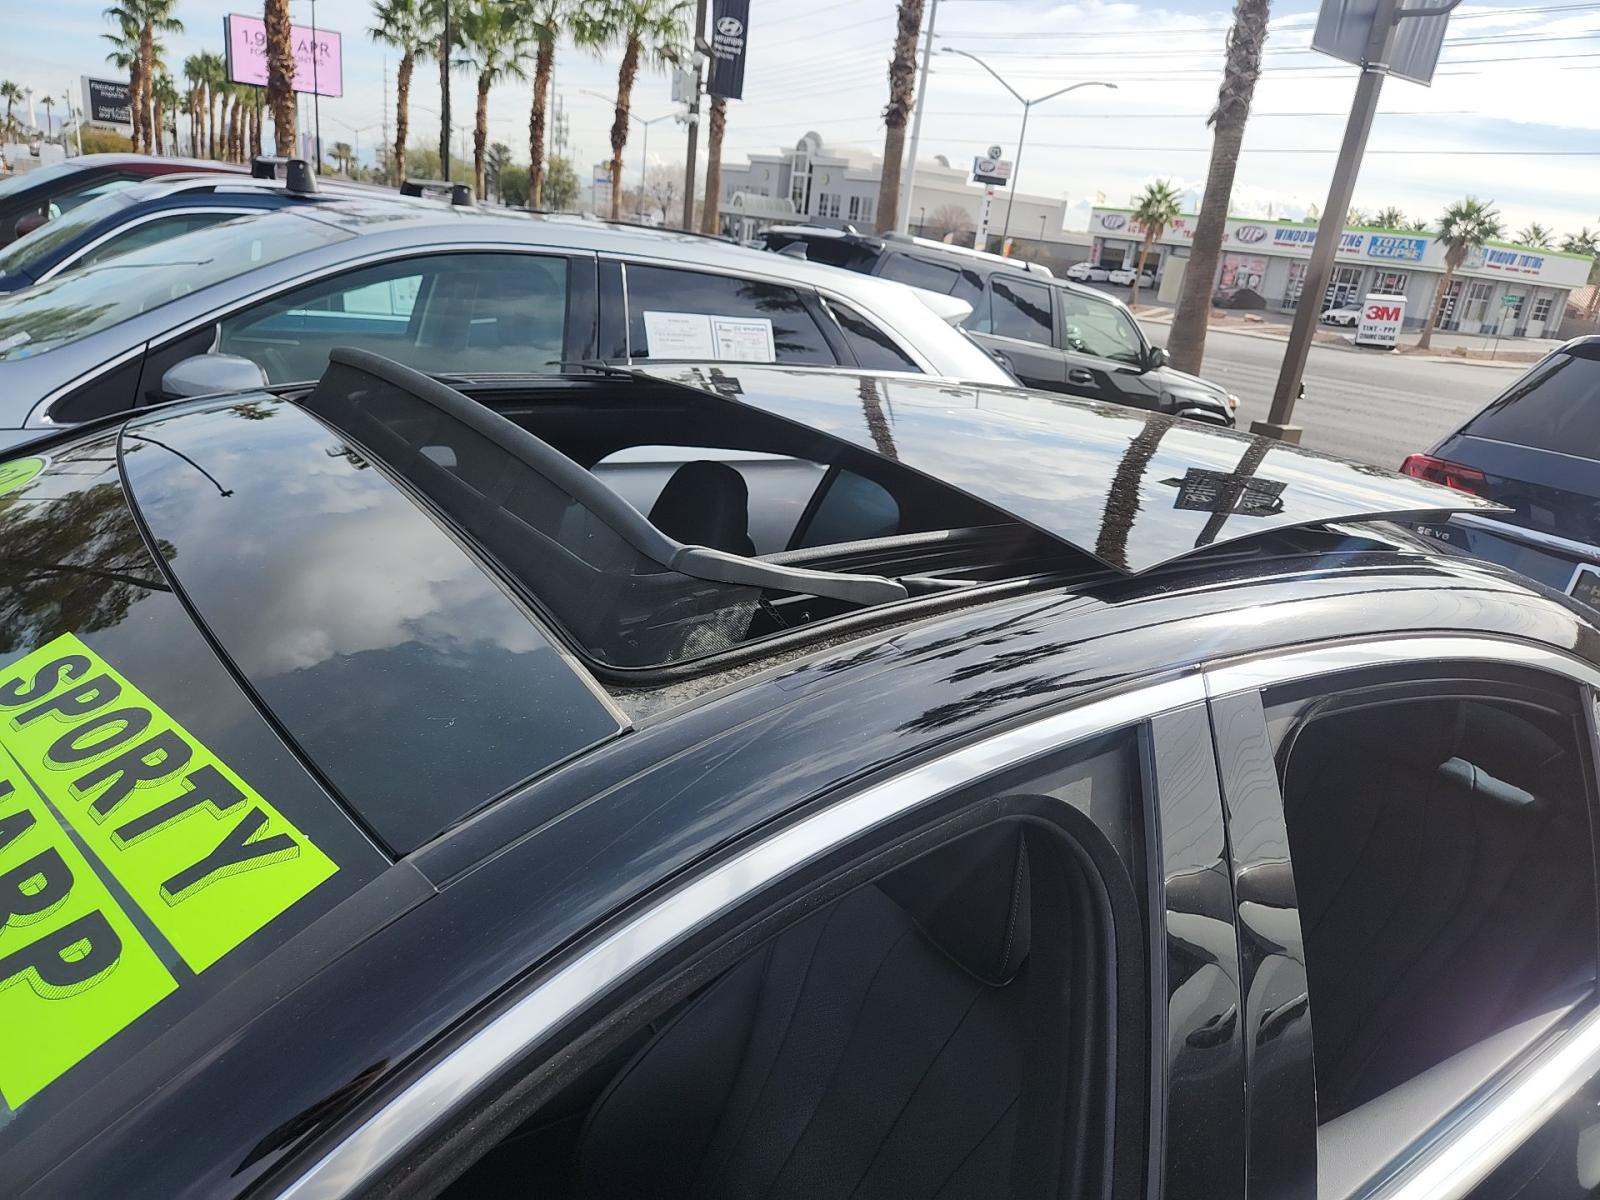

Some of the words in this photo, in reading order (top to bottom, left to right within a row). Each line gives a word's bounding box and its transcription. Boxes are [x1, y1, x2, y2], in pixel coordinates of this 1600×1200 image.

[297, 40, 330, 58] APR
[1103, 215, 1124, 228] VIP
[1241, 226, 1263, 241] VIP
[1275, 228, 1317, 243] WINDOW
[1366, 305, 1401, 321] 3M
[1363, 324, 1377, 332] TINT
[1416, 526, 1432, 536] SE
[0, 654, 301, 908] SPORTY
